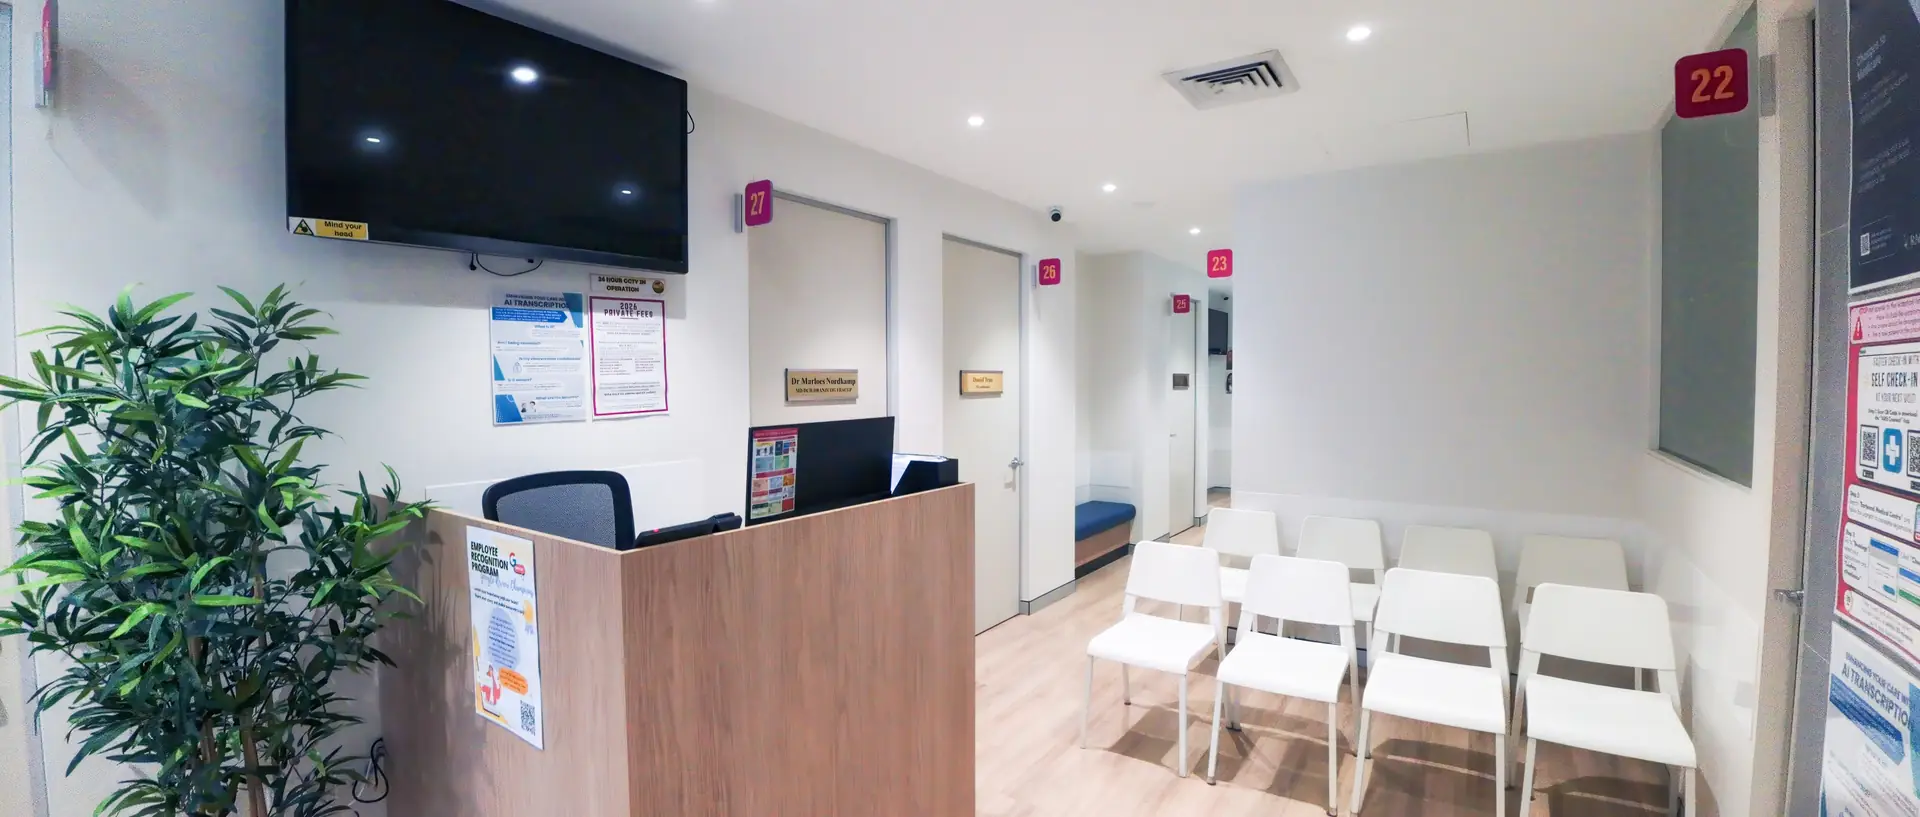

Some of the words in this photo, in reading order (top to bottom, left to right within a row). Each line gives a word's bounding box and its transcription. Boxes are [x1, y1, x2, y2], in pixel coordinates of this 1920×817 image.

[1691, 65, 1735, 103] 22
[751, 191, 765, 216] 27
[1212, 256, 1227, 271] 23
[1043, 264, 1056, 279] 26
[606, 285, 640, 293] OPERATION
[620, 302, 638, 310] 2026
[1176, 299, 1187, 309] 25
[604, 309, 634, 317] PRIVATE
[791, 377, 800, 385] Dr
[1871, 372, 1885, 387] SELF
[1886, 371, 1918, 387] CHECK-IN
[471, 541, 498, 557] EMPLOYEE
[471, 552, 509, 570] RECOGNITION
[472, 561, 499, 577] PROGRAM
[1841, 663, 1849, 678] AI
